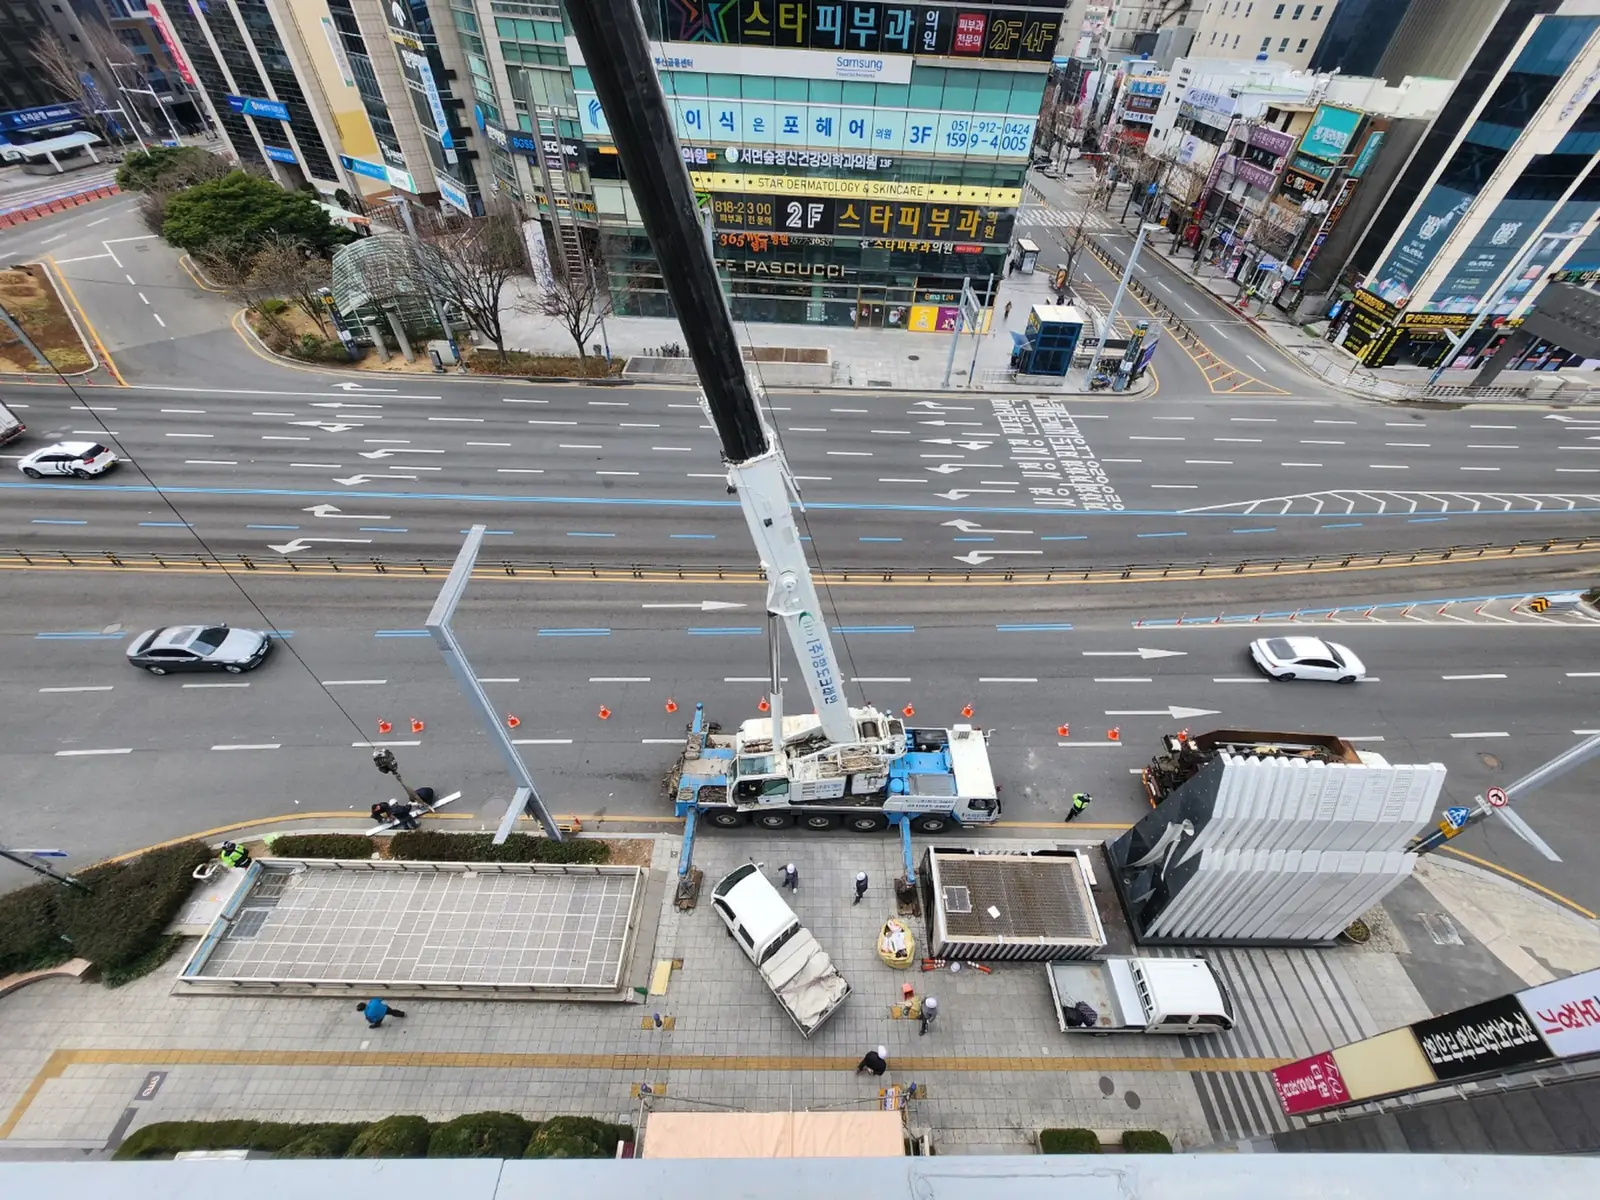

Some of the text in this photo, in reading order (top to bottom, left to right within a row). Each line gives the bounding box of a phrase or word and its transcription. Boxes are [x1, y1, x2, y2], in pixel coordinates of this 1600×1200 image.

[744, 1, 914, 49] 스타피부과
[923, 10, 939, 50] 의원
[959, 19, 984, 31] 피부과
[957, 34, 981, 47] 전문의
[990, 19, 1022, 50] 2F
[836, 56, 883, 71] Samsung
[910, 126, 932, 143] 3F
[952, 120, 1030, 136] 051-912-0424
[946, 132, 1028, 150] 1599-4005
[758, 177, 924, 196] STAR DERMATOLOGY & SKINCARE
[715, 201, 771, 215] 818-2300
[786, 202, 824, 229] 2F
[720, 213, 743, 224] 피부과
[838, 203, 981, 238] 스타피부과
[984, 211, 998, 239] 의원
[874, 239, 954, 254] 스타피부과의원
[744, 260, 845, 278] PASCUCCI
[924, 293, 955, 301] emat24
